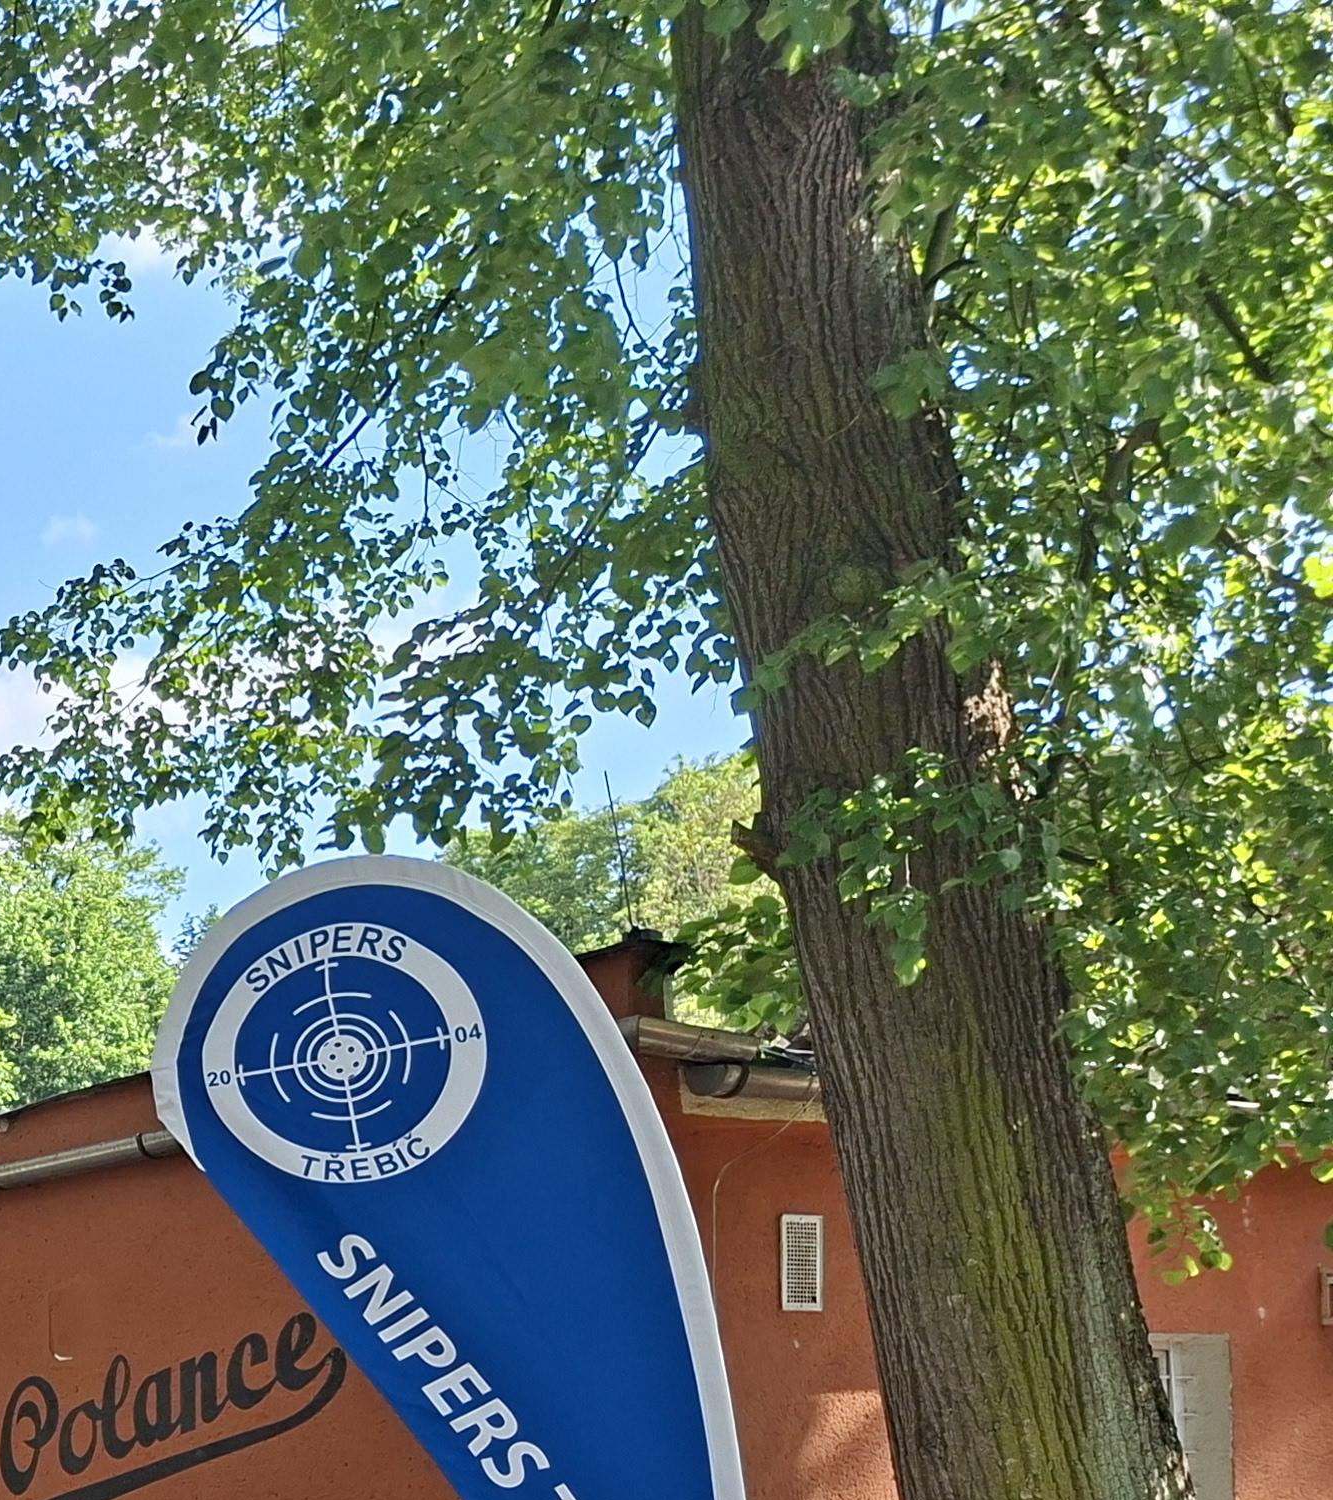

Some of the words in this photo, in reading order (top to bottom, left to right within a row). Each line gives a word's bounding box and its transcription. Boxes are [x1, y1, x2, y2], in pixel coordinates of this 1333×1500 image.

[245, 924, 408, 994] SNIPERS
[207, 1071, 232, 1088] 20
[455, 1022, 483, 1044] 04
[300, 1133, 431, 1182] TŘEBÍČ
[316, 1233, 550, 1489] SNIPERS
[0, 1312, 347, 1496] Polance
